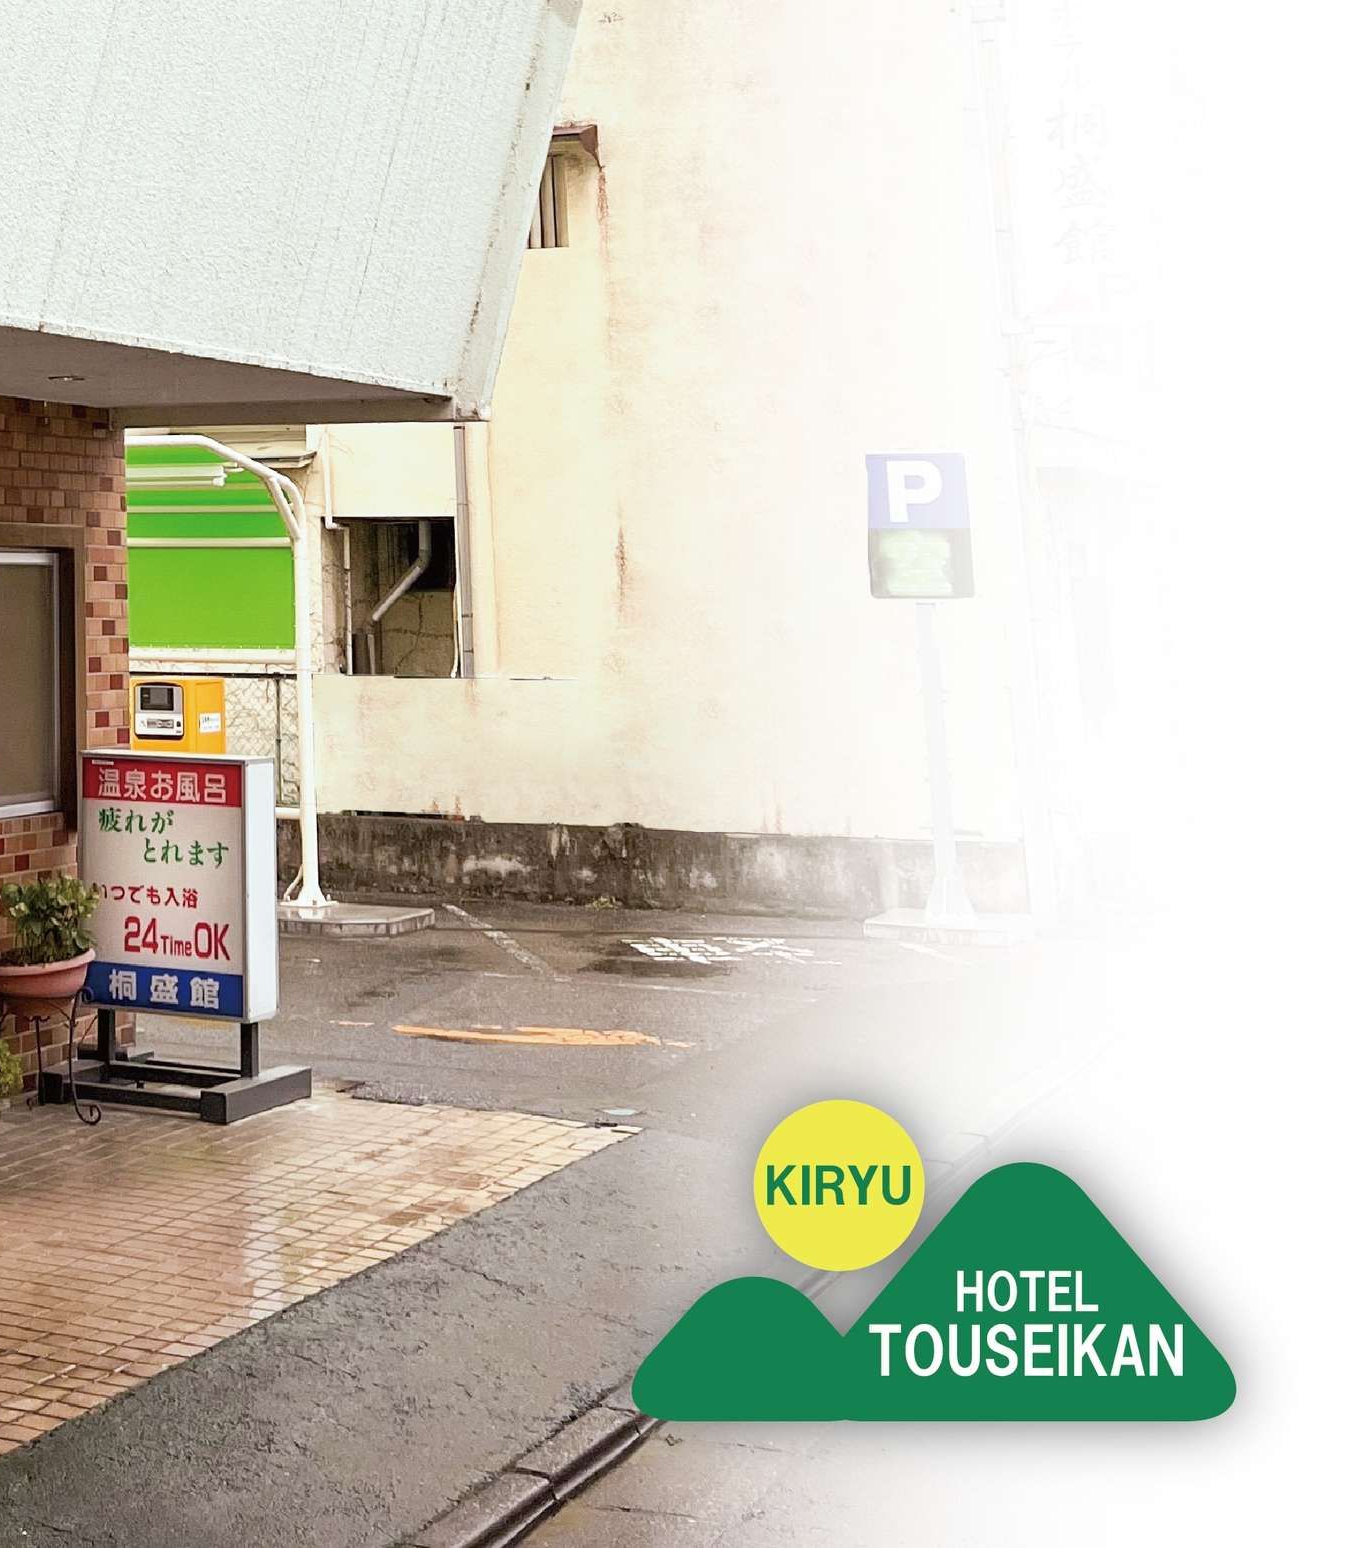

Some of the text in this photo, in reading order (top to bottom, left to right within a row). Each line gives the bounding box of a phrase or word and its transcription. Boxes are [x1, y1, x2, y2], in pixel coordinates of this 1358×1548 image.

[886, 460, 943, 522] P
[98, 767, 227, 803] 温泉お風呂
[98, 807, 175, 834] 疲れが
[143, 837, 230, 869] とれます
[108, 968, 220, 1009] 桐盛館
